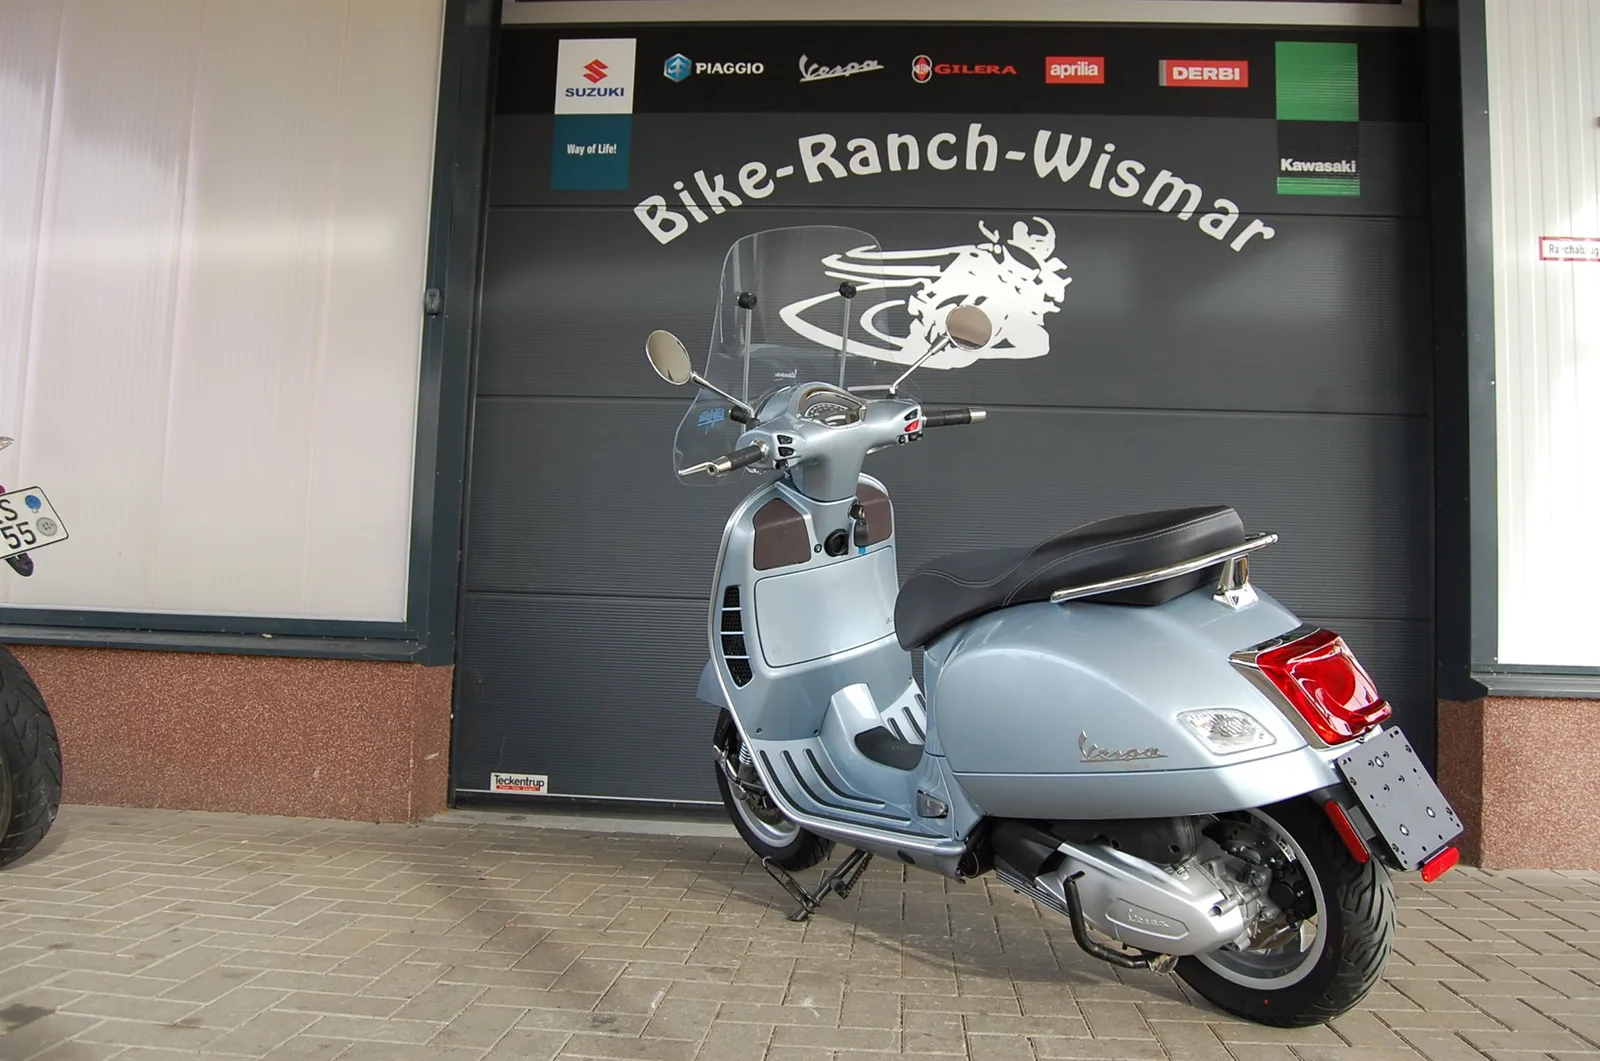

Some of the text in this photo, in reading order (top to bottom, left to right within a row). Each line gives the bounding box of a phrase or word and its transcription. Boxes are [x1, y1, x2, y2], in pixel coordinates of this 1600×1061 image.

[695, 61, 765, 76] PIAGGIO
[799, 53, 885, 82] Vespa
[933, 63, 1018, 75] GILERA
[1050, 60, 1099, 79] aprilia
[1172, 65, 1241, 81] DERBI
[564, 87, 625, 98] SUZUKI
[566, 143, 617, 156] Way of Life!
[1280, 157, 1357, 173] Kawasaki
[633, 122, 1276, 252] Bike-Ranch-Wismar
[1078, 730, 1169, 763] Vespa
[494, 774, 545, 791] Teckentrup
